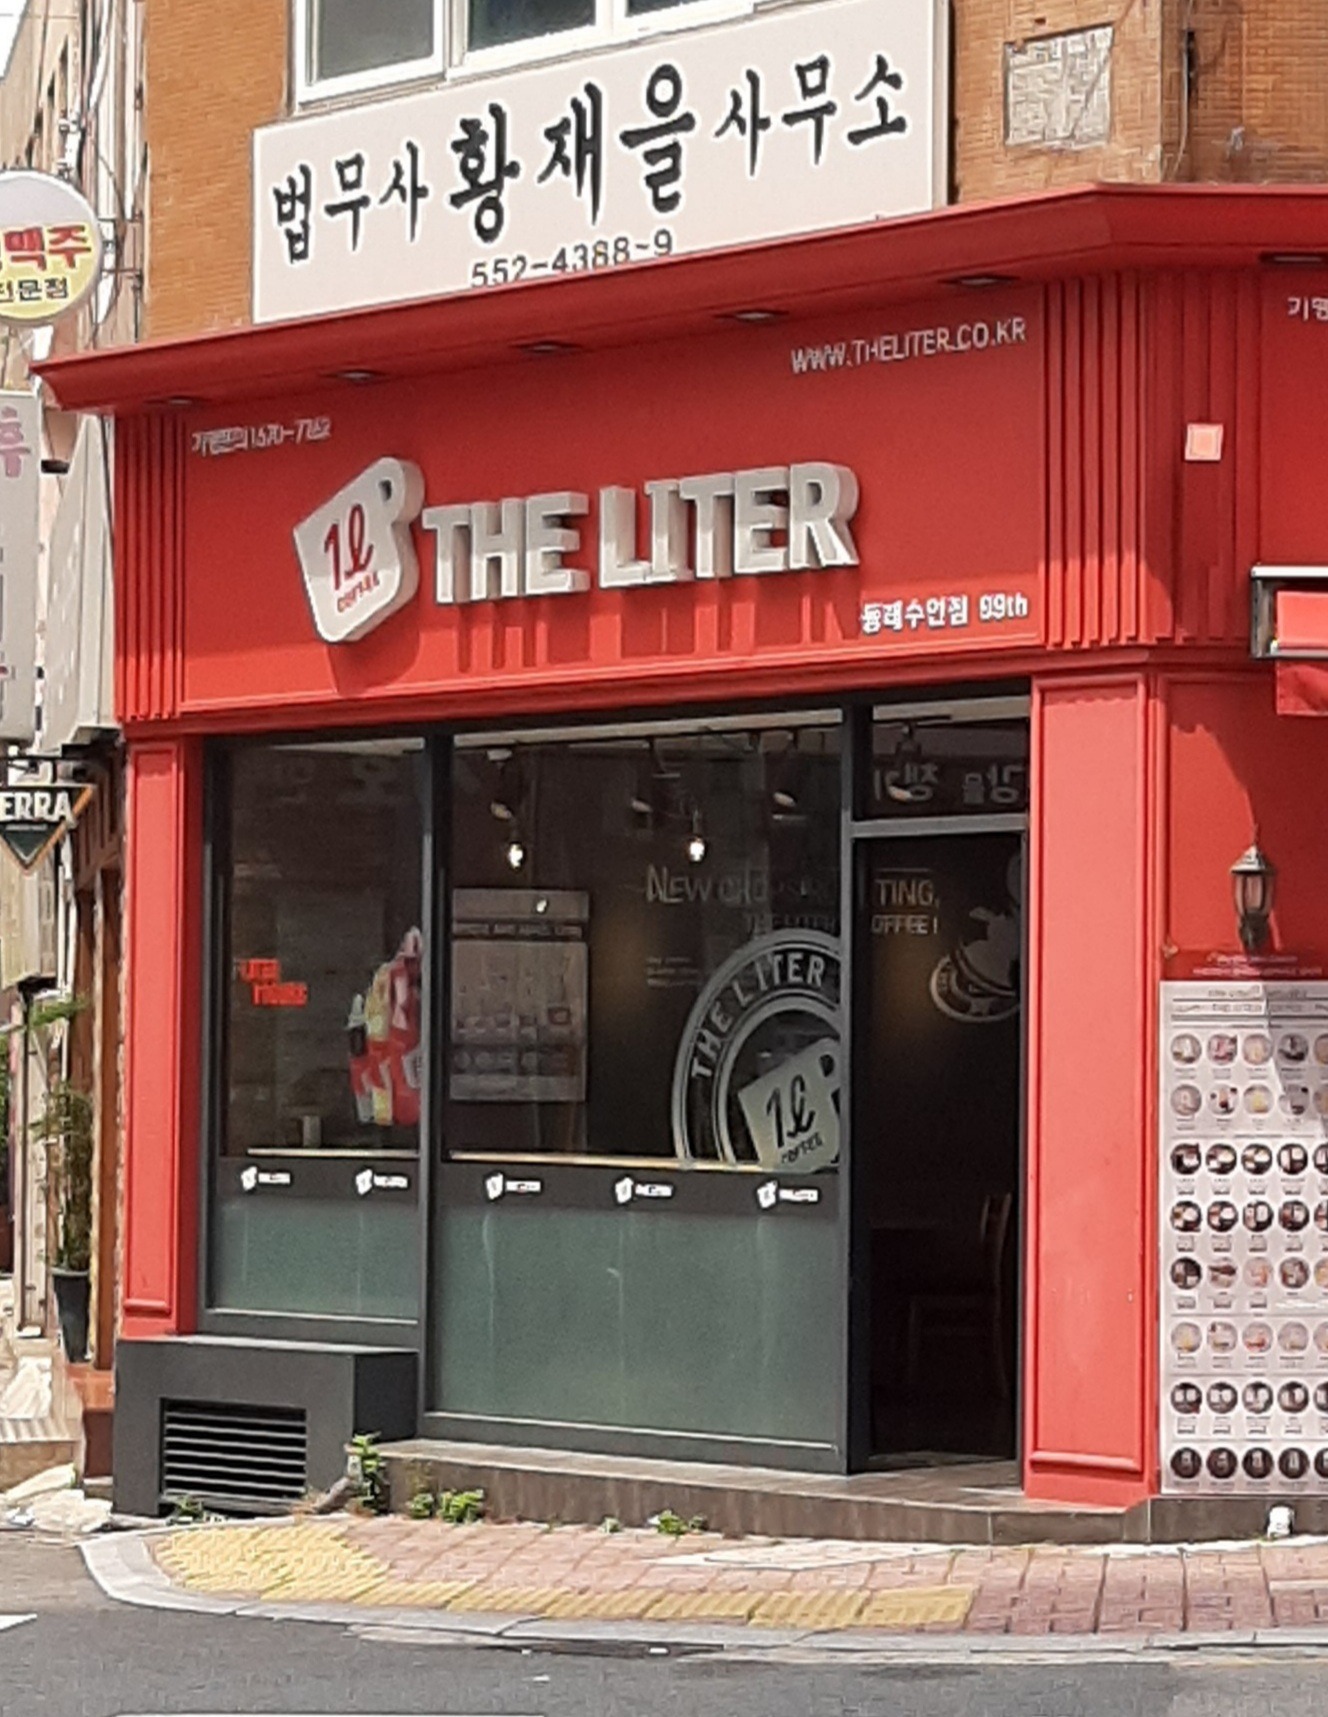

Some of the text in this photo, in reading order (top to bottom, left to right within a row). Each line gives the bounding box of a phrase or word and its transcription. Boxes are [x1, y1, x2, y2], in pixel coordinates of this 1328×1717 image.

[271, 53, 908, 265] 법무사 황재을 사무소
[0, 225, 92, 271] 맥주
[422, 462, 860, 604] THE LITER
[0, 792, 75, 830] ERRA
[691, 1002, 733, 1078] THE
[732, 951, 826, 1007] LITER
